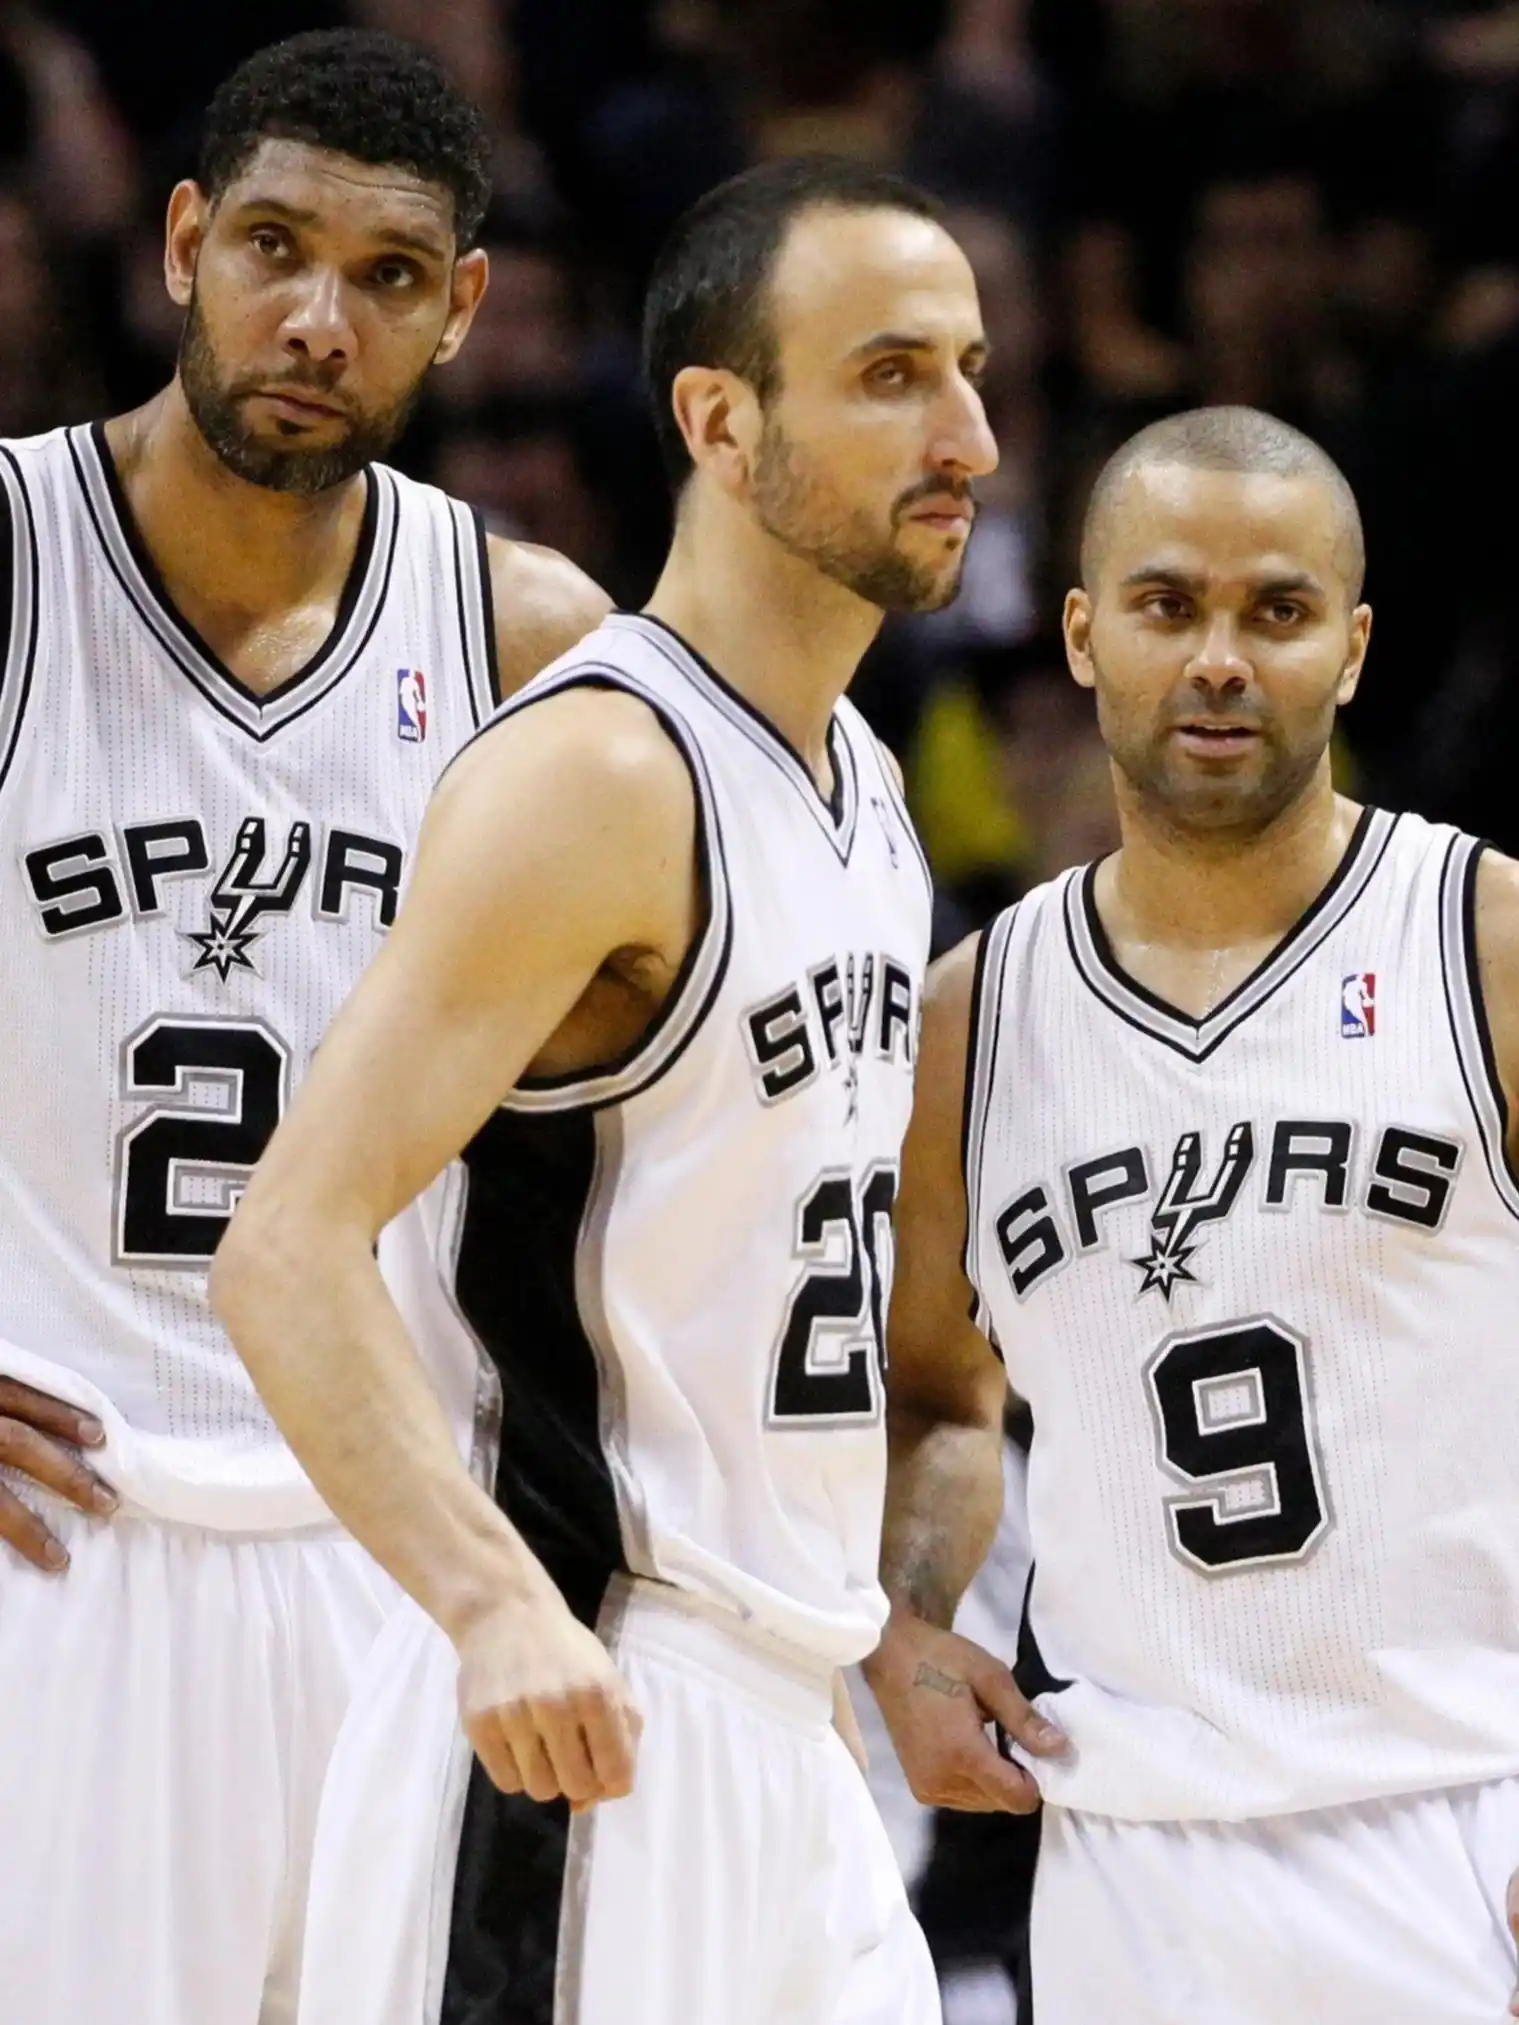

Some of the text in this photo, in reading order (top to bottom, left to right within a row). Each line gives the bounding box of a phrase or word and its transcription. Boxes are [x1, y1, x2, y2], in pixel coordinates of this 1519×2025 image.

[20, 815, 403, 984] SPUR
[738, 951, 922, 1110] SPUR
[994, 1118, 1464, 1310] SPURS
[1141, 1312, 1336, 1580] 9
